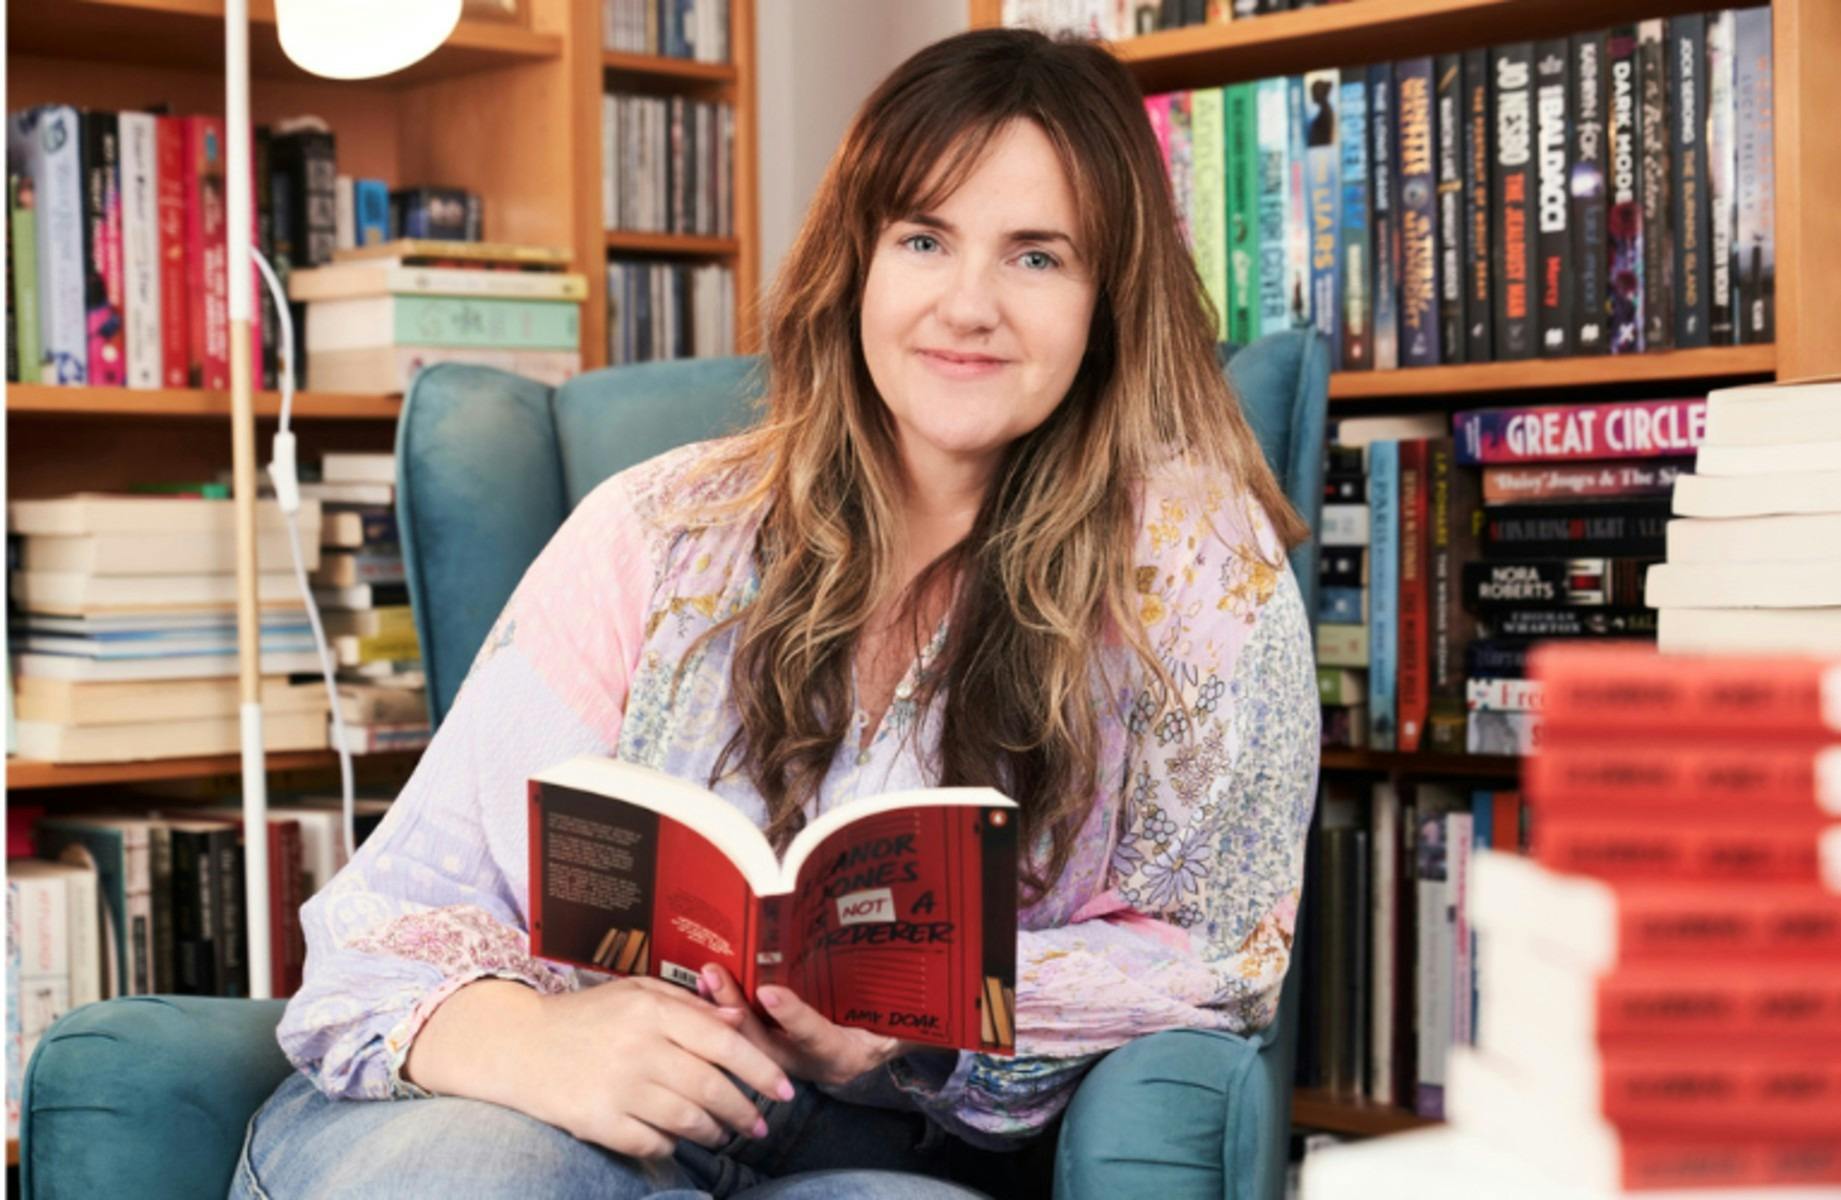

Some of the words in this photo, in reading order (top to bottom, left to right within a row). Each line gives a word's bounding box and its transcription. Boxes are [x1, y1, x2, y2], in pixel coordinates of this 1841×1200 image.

[1498, 57, 1528, 88] JO
[1680, 38, 1694, 78] JOCK
[1374, 82, 1387, 111] THE
[1473, 85, 1485, 112] THE
[1613, 61, 1633, 130] DARK
[1681, 80, 1696, 144] SERONG
[1742, 73, 1754, 120] LUCY
[1197, 99, 1216, 158] Ann
[1375, 116, 1387, 161] LONG
[1473, 116, 1485, 183] PORTRAIT
[1262, 151, 1283, 193] RUN
[1539, 97, 1566, 233] BALDACCI
[1615, 134, 1635, 205] MODE
[1682, 150, 1696, 178] THE
[1376, 165, 1388, 211] GAME
[1474, 187, 1486, 207] OF
[1504, 173, 1524, 202] THE
[1643, 155, 1663, 219] Eaters
[1262, 200, 1283, 241] FOR
[1315, 188, 1335, 270] LIARS
[1683, 181, 1697, 250] BURNING
[1504, 207, 1525, 281] JEALOUSY
[1261, 249, 1285, 318] COVER
[1506, 284, 1526, 318] MAN
[1545, 256, 1562, 307] Mercy
[1685, 253, 1698, 306] ISLAND
[1506, 410, 1598, 456] GREAT
[1604, 403, 1707, 452] CIRCLE
[1493, 470, 1548, 494] Daisy
[1546, 469, 1595, 493] Jones
[1598, 471, 1616, 488] &
[1620, 468, 1653, 487] The
[1373, 480, 1391, 545] PARIS
[1435, 480, 1449, 546] POMARE
[1585, 515, 1625, 540] LIGHT
[1436, 554, 1448, 578] THE
[1492, 566, 1539, 581] NORA
[1437, 582, 1448, 631] WRONG
[1478, 581, 1555, 600] ROBERTS
[1502, 621, 1581, 633] WHARTON
[841, 898, 888, 919] NOT
[911, 890, 937, 915] A
[814, 921, 956, 950] RDERER
[844, 1008, 883, 1024] AMY
[887, 1011, 941, 1029] DOAK
